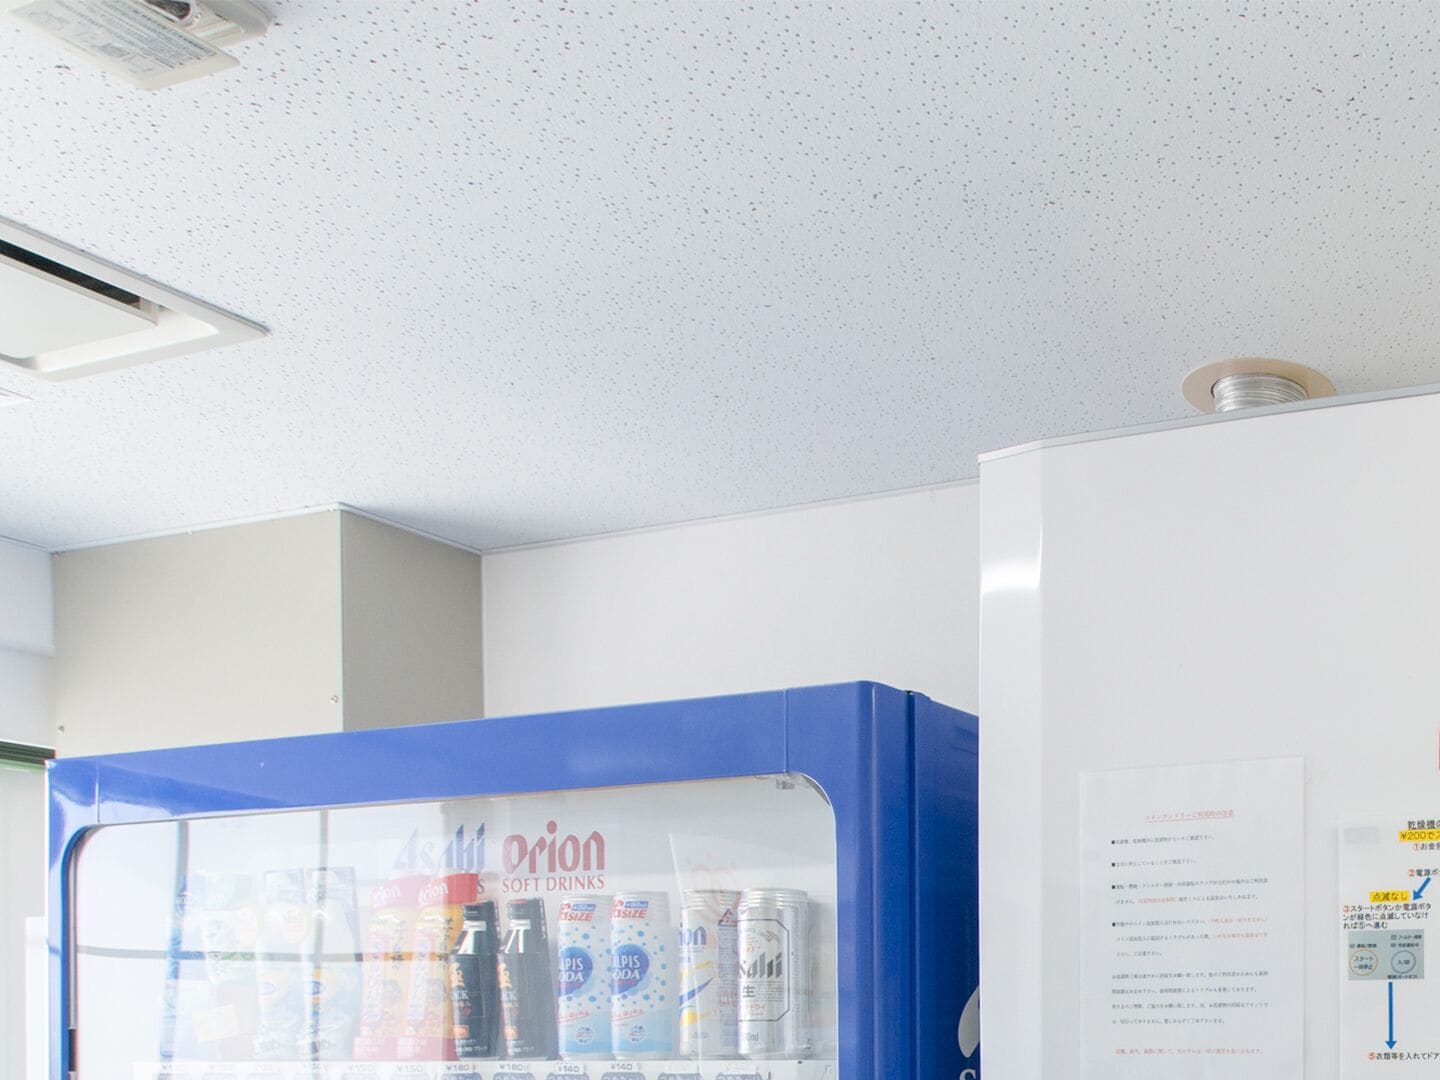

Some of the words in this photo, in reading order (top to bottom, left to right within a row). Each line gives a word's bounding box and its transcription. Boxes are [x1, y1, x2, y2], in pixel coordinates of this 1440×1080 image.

[503, 877, 540, 893] SOFT
[546, 874, 605, 892] DRINKS
[1372, 891, 1409, 901] 点滅なし
[743, 985, 755, 997] 生
